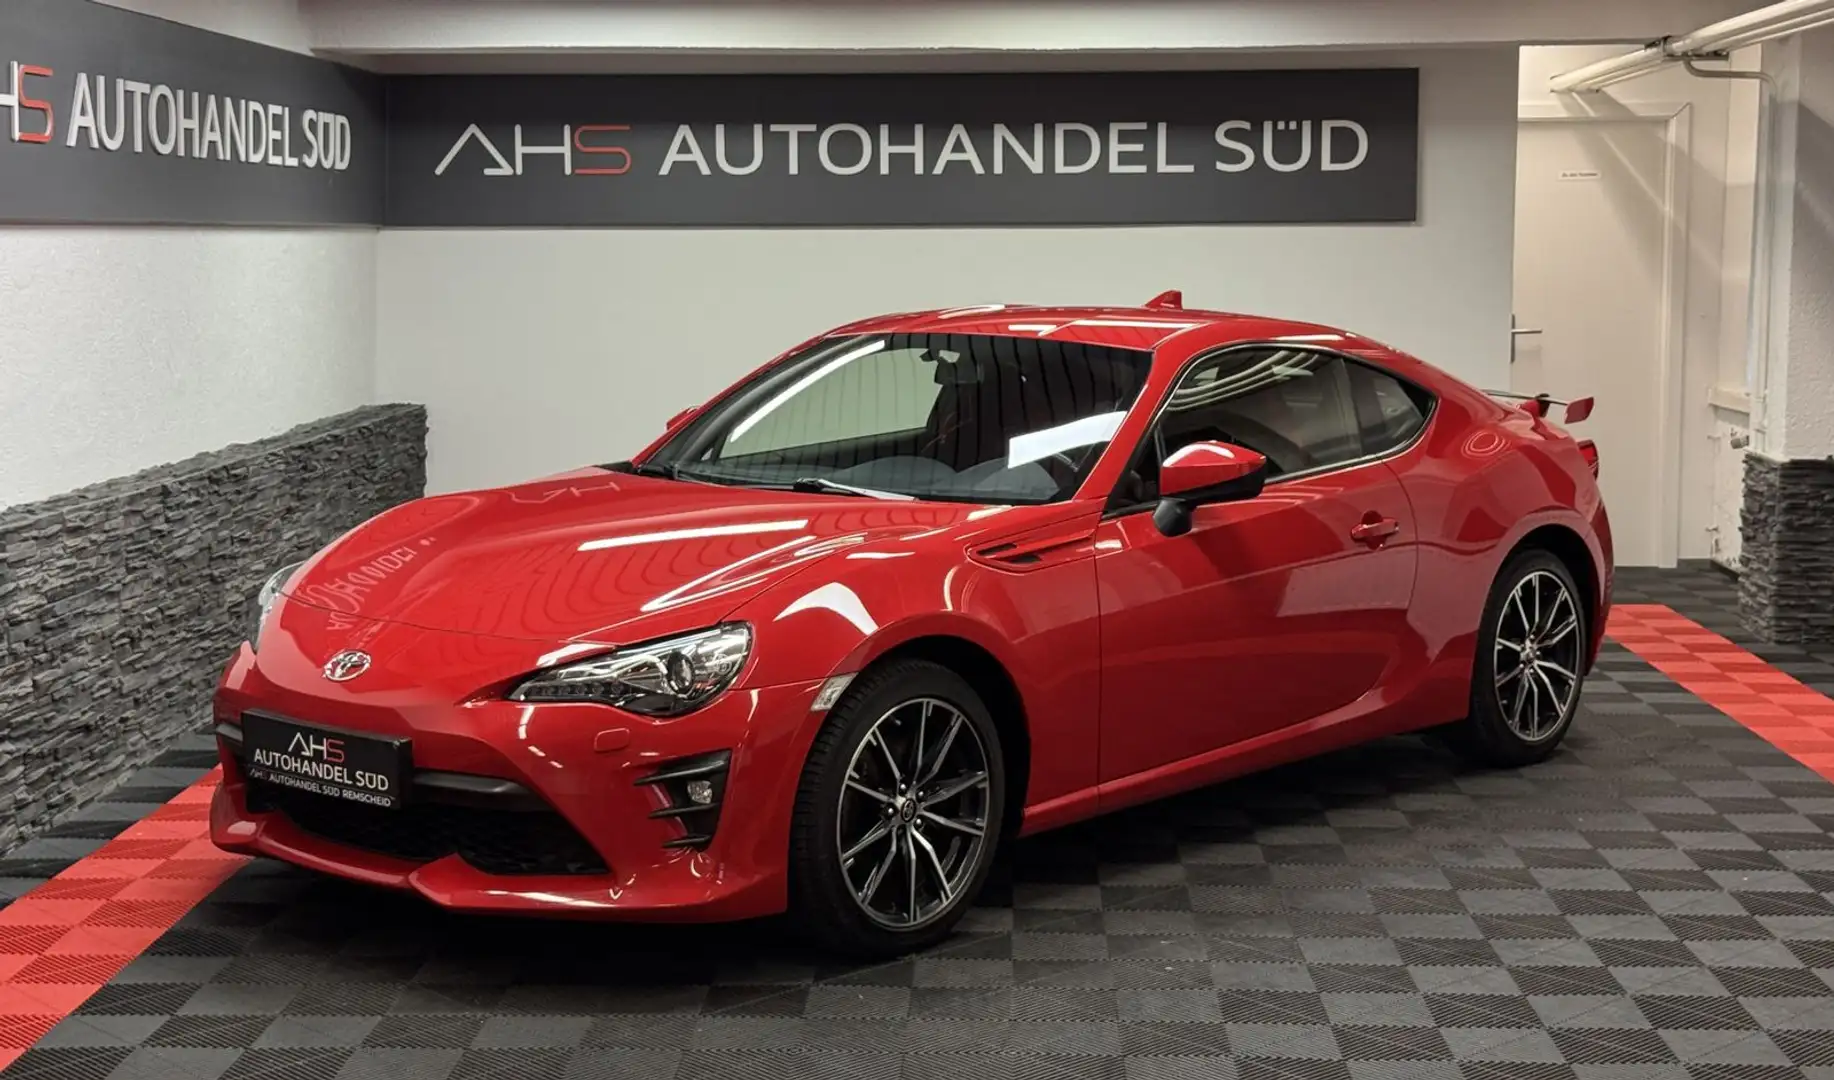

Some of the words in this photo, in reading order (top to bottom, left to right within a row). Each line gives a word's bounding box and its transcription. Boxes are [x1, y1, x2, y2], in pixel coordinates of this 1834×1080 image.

[66, 72, 298, 167] AUTOHANDEL
[301, 108, 351, 171] SÜD
[434, 123, 632, 176] AHS
[658, 121, 1194, 176] AUTOHANDEL
[1214, 119, 1369, 173] SÜD
[288, 732, 345, 763] AHS
[254, 748, 352, 785] AUTOHANDEL
[355, 770, 389, 791] SÜD
[269, 773, 321, 794] AUTOHANDEL
[342, 791, 391, 807] REMSCHEID
